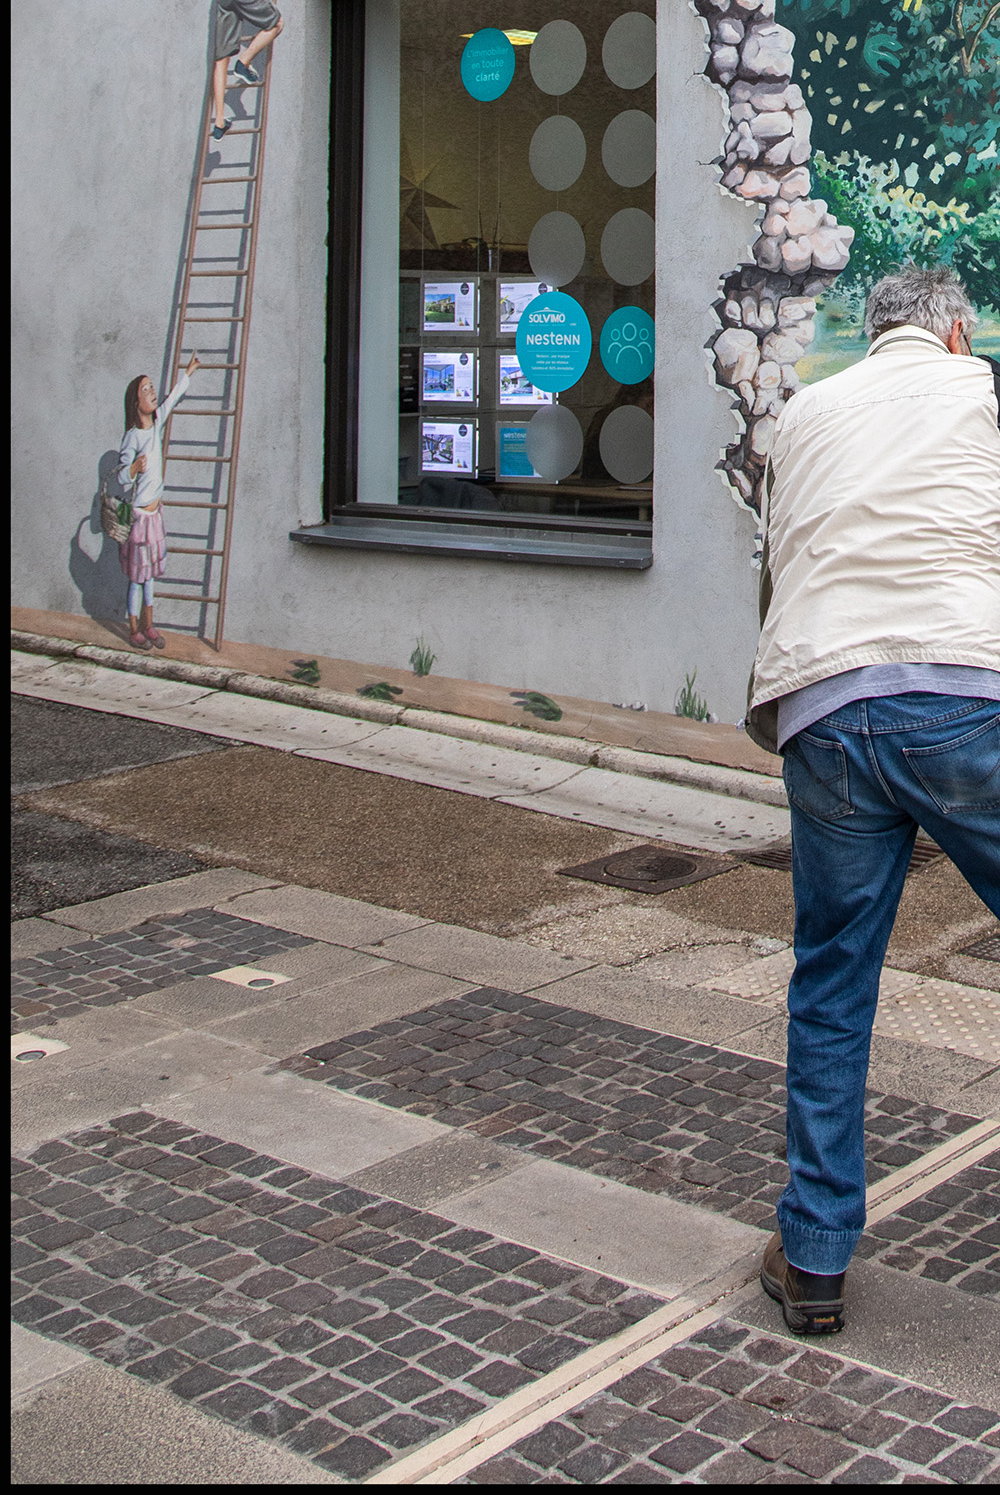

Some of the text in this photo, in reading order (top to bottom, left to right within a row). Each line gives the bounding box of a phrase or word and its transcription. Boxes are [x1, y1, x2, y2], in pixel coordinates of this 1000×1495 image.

[482, 59, 505, 69] toute
[475, 70, 500, 82] clarté
[528, 313, 566, 323] SOLVIMO
